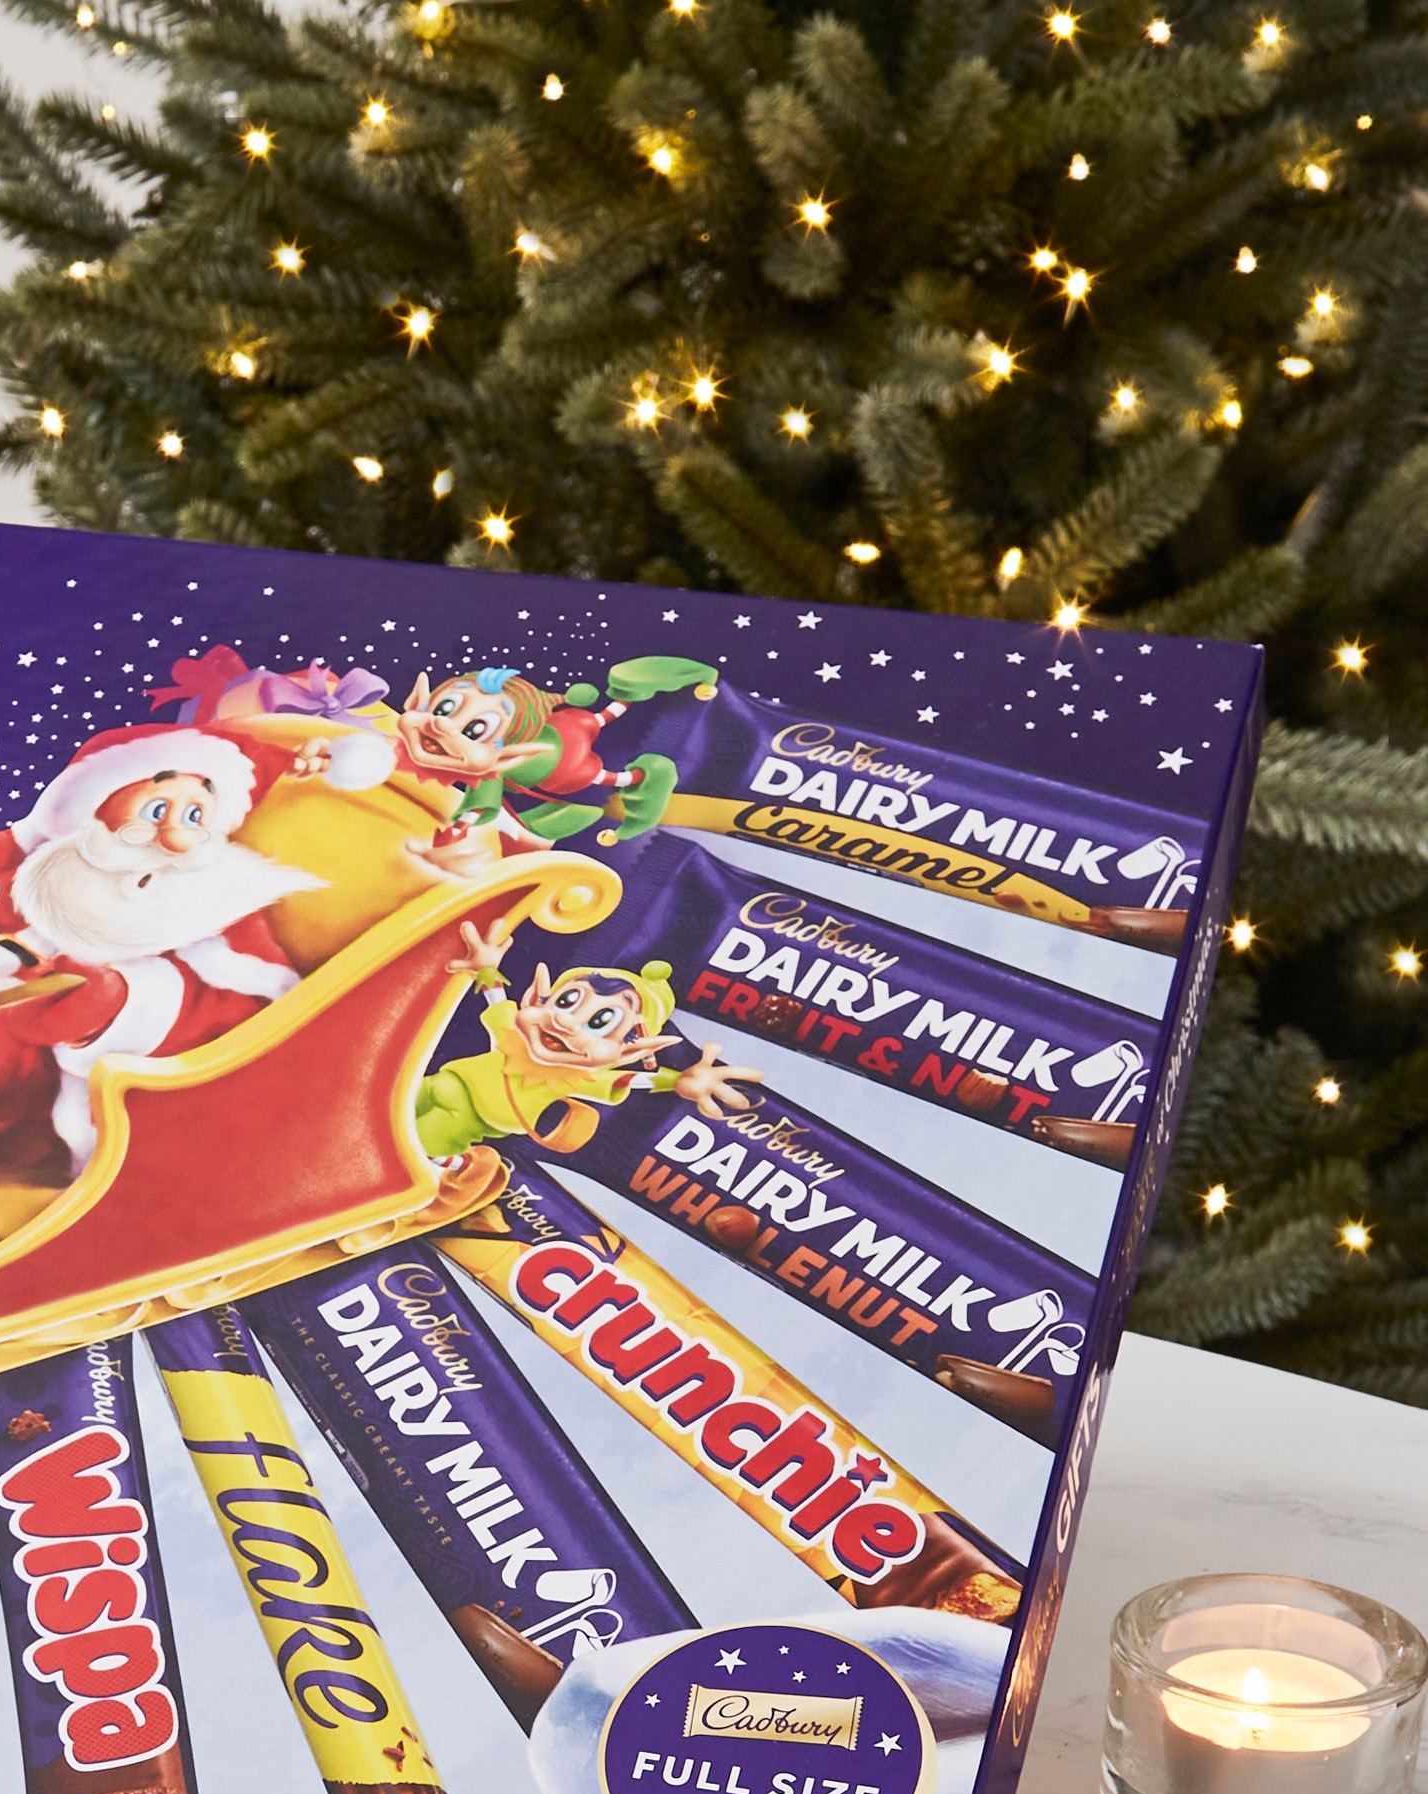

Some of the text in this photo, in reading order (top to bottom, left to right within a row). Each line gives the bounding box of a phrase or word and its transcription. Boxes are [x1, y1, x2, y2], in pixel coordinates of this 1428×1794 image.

[749, 755, 1119, 886] DAIRY MILK
[771, 721, 934, 796] Cadbury
[731, 802, 1013, 897] Caramel
[707, 926, 1074, 1093] DAIRY MILK
[738, 891, 900, 980] Cadbury
[857, 1035, 904, 1077] &
[654, 1114, 996, 1334] DAIRY MILK
[378, 1265, 482, 1396] Cadbury
[291, 1317, 453, 1546] THE CLASSIC CREAMY TASTE
[316, 1284, 557, 1588] DAIRY MILK
[512, 1240, 920, 1576] crunchie
[1055, 1361, 1100, 1554] GIFTS
[0, 1430, 177, 1768] Wispa
[701, 1695, 845, 1745] Cadbury
